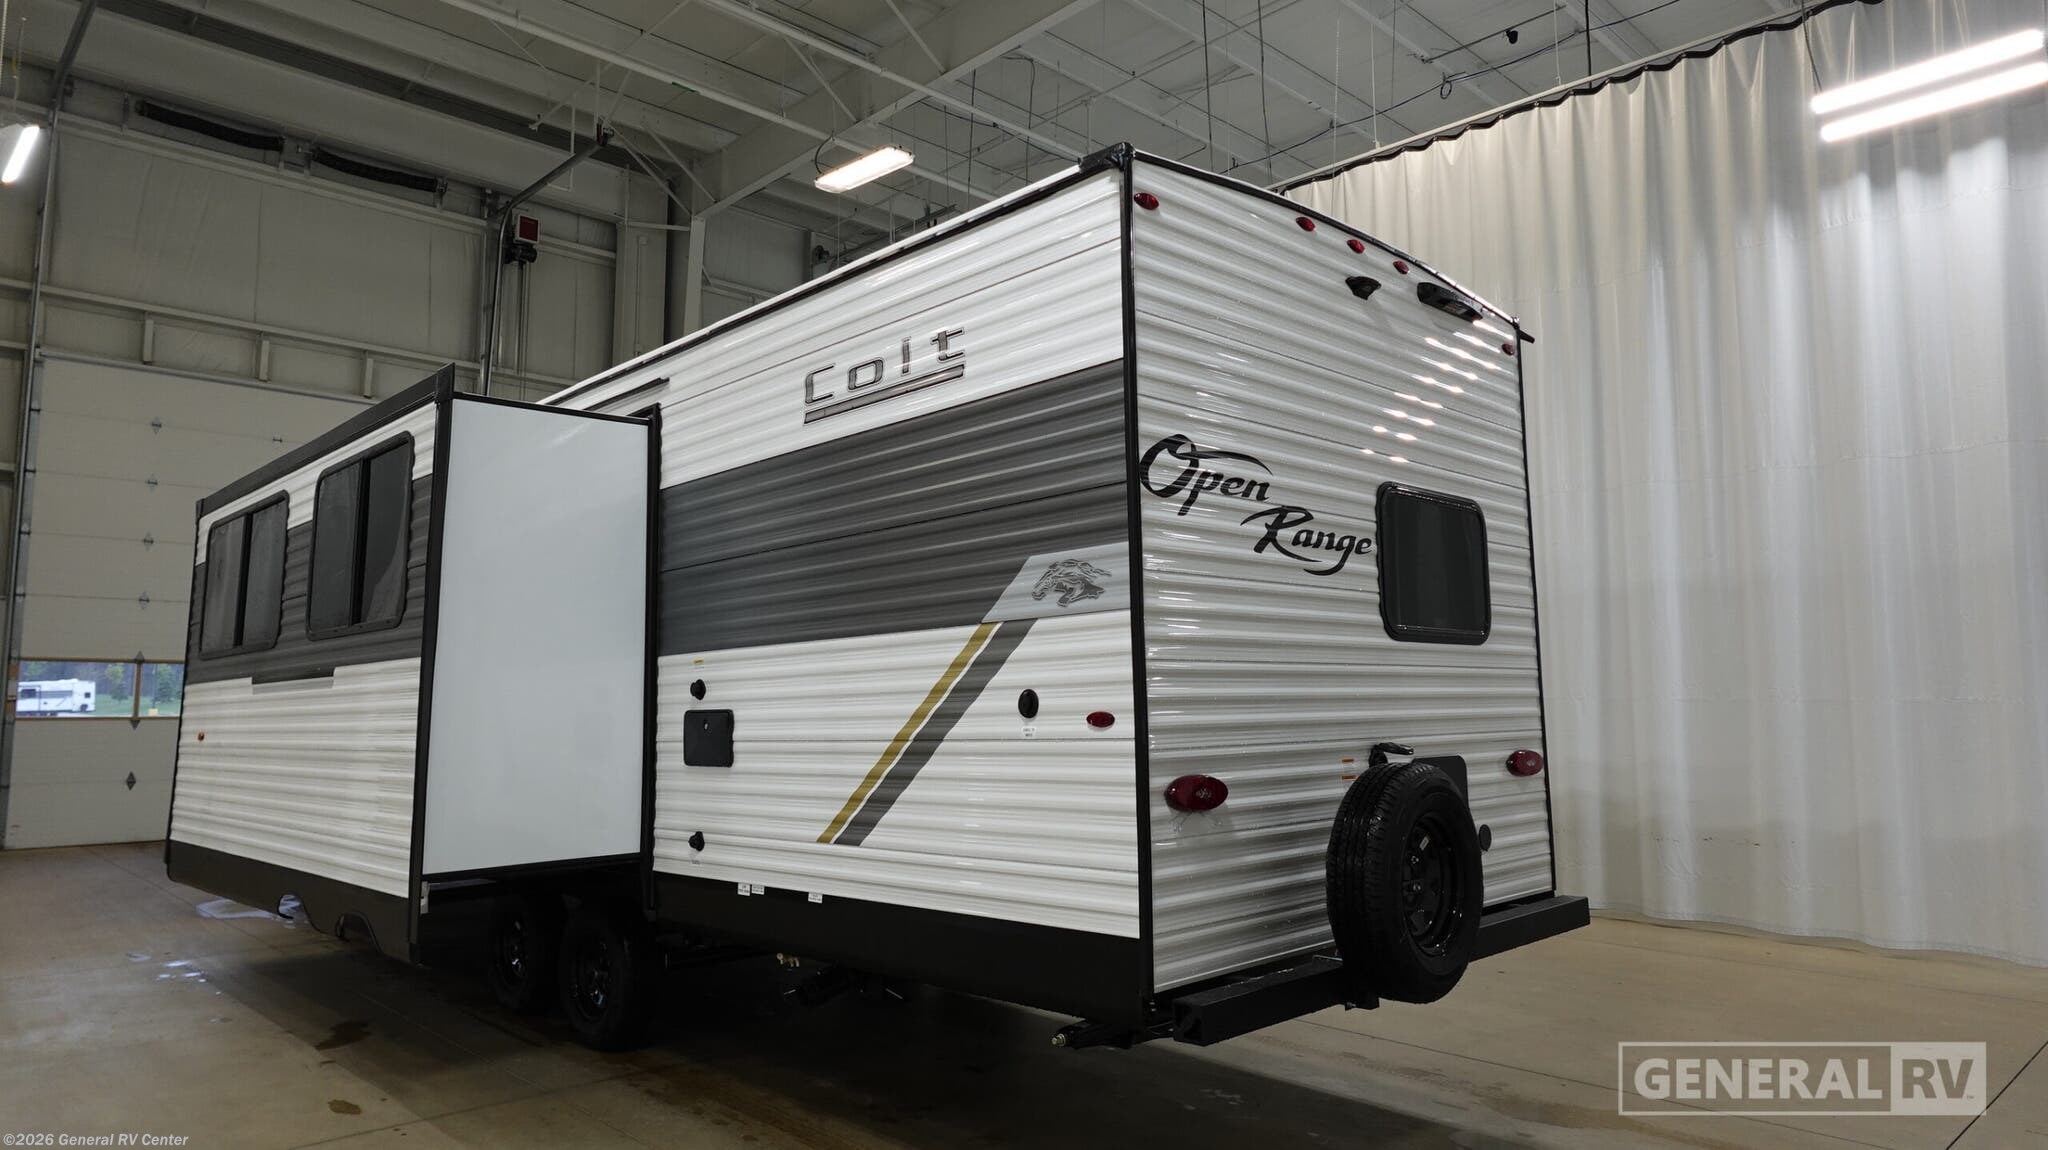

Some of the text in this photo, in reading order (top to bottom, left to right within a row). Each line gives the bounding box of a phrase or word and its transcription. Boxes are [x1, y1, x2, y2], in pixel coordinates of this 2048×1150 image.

[804, 327, 965, 404] Colt
[1138, 433, 1273, 517] Open
[1239, 505, 1372, 576] Range
